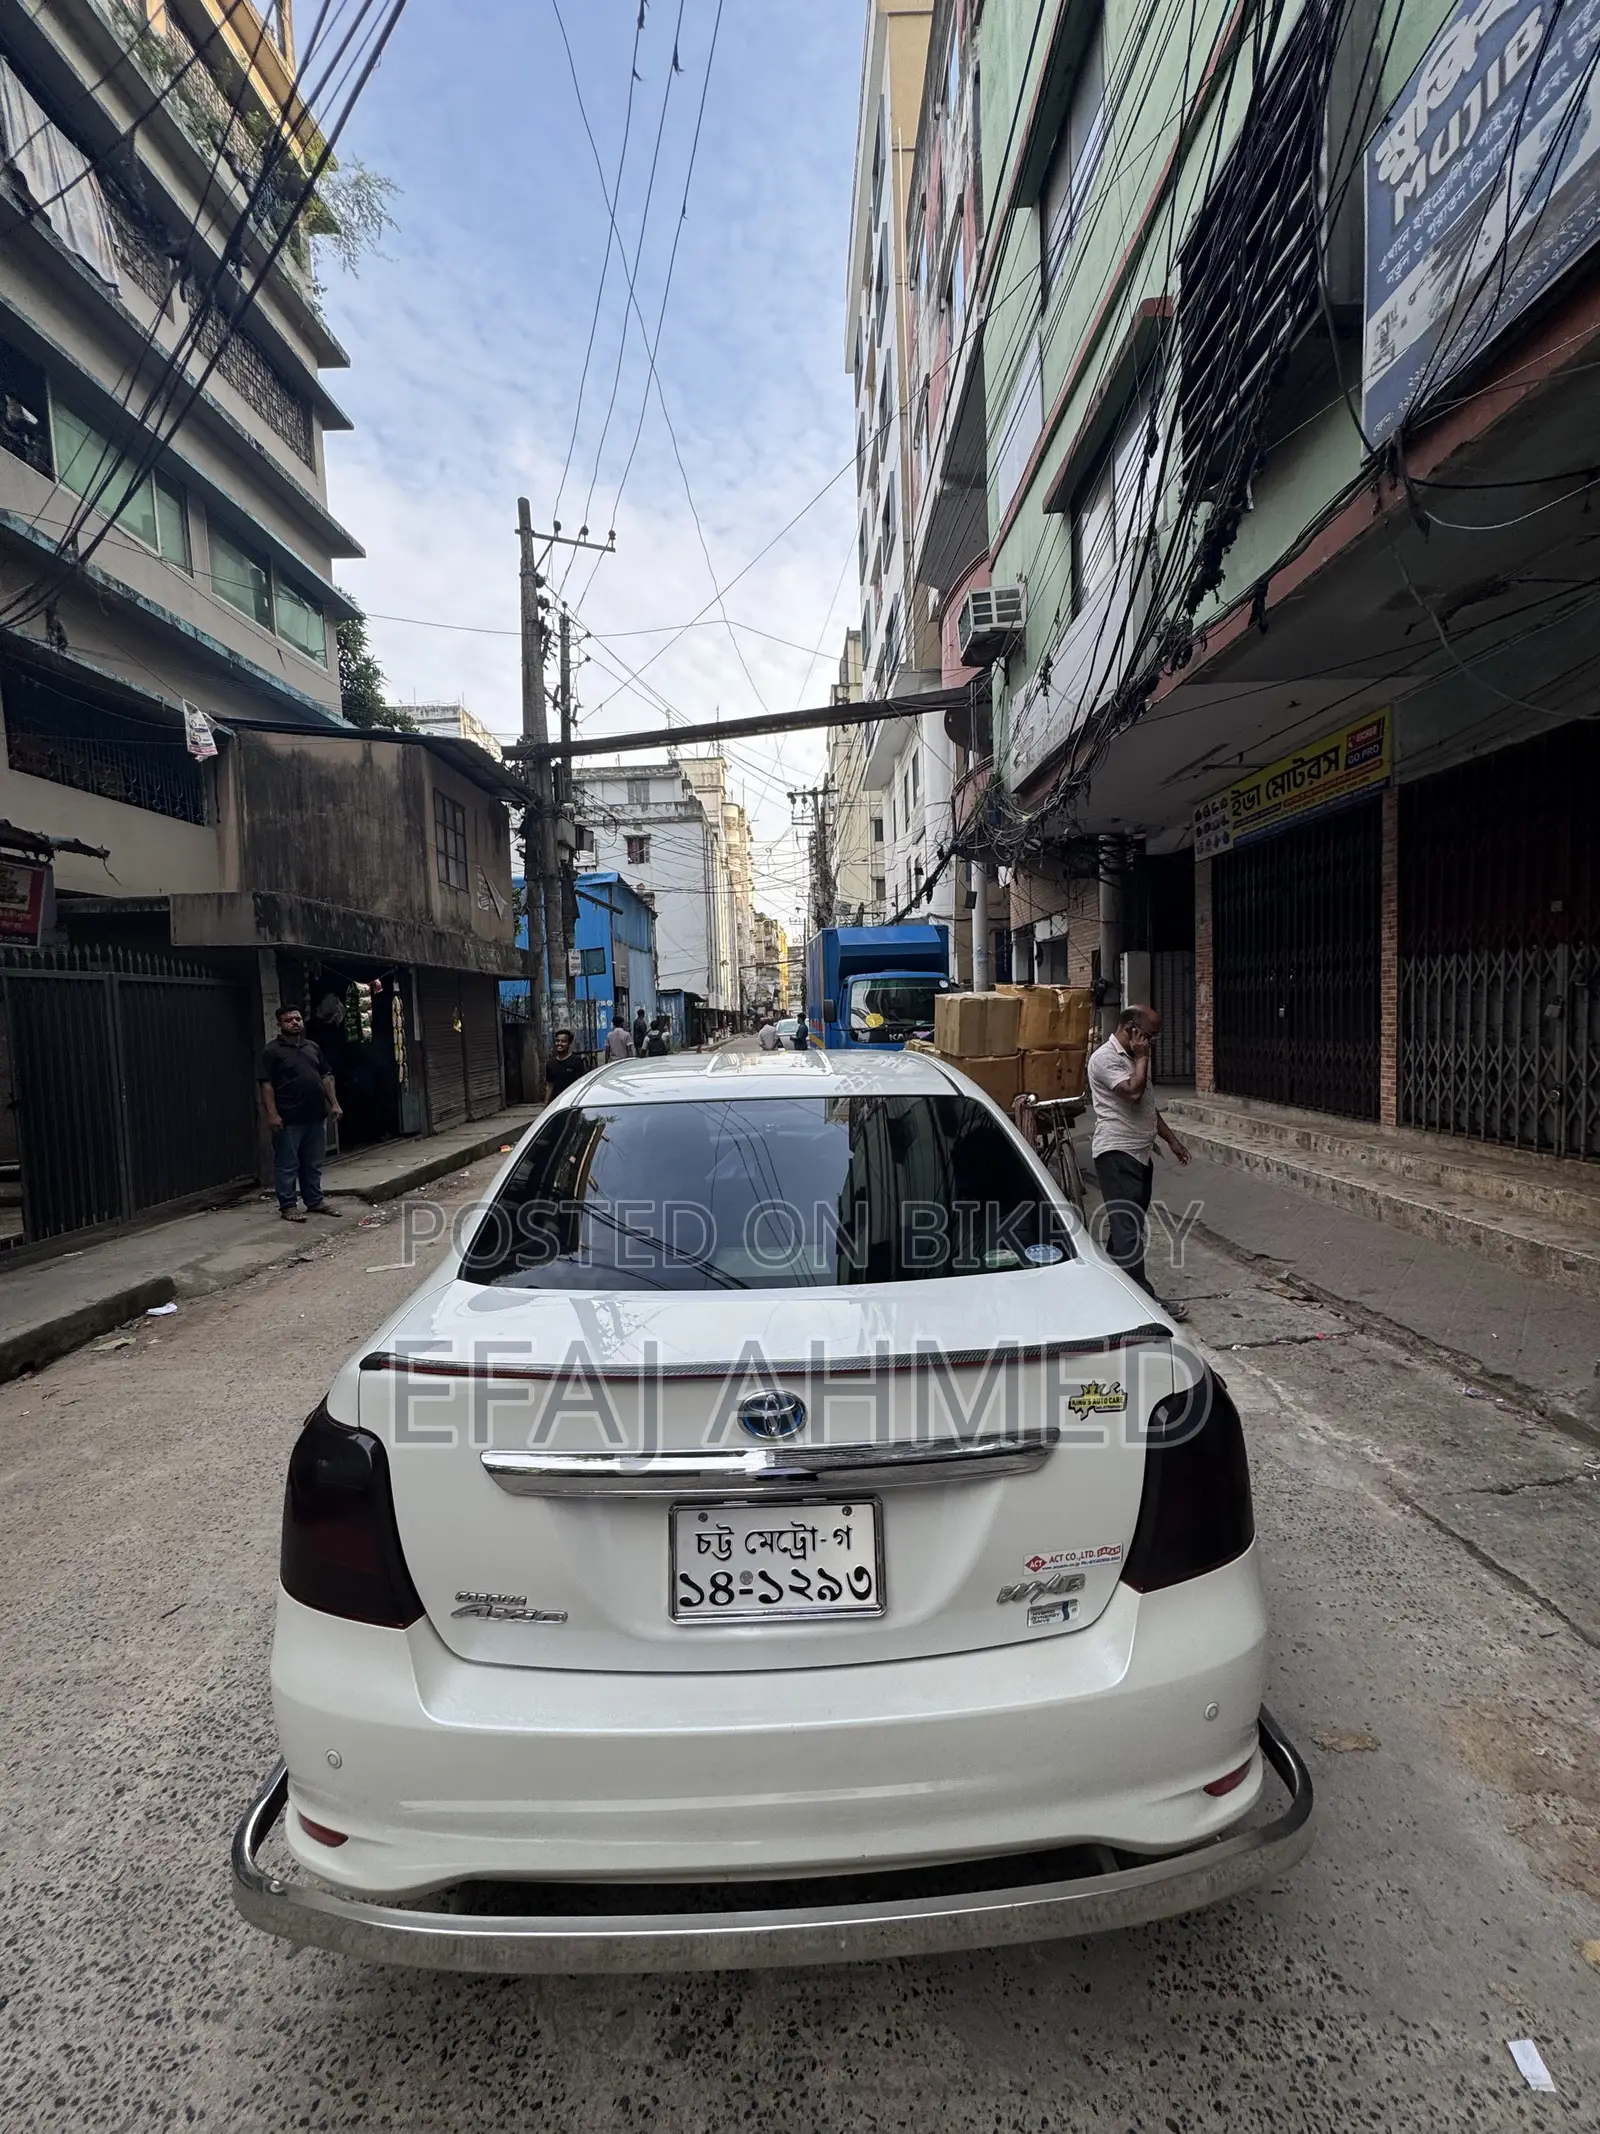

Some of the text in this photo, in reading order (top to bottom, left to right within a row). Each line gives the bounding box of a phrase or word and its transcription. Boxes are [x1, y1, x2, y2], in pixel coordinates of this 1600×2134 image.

[1394, 5, 1544, 226] MUJIB
[1386, 249, 1411, 285] নতুন
[1348, 744, 1380, 765] GO PRO
[1231, 784, 1261, 817] ইভা
[1265, 745, 1341, 801] মোটরস
[1108, 1396, 1124, 1404] CARE
[1029, 1560, 1043, 1569] ACT
[1048, 1554, 1064, 1564] ACT
[679, 1564, 873, 1608] ১৪-১২৯৩
[455, 1591, 528, 1606] COROLLA
